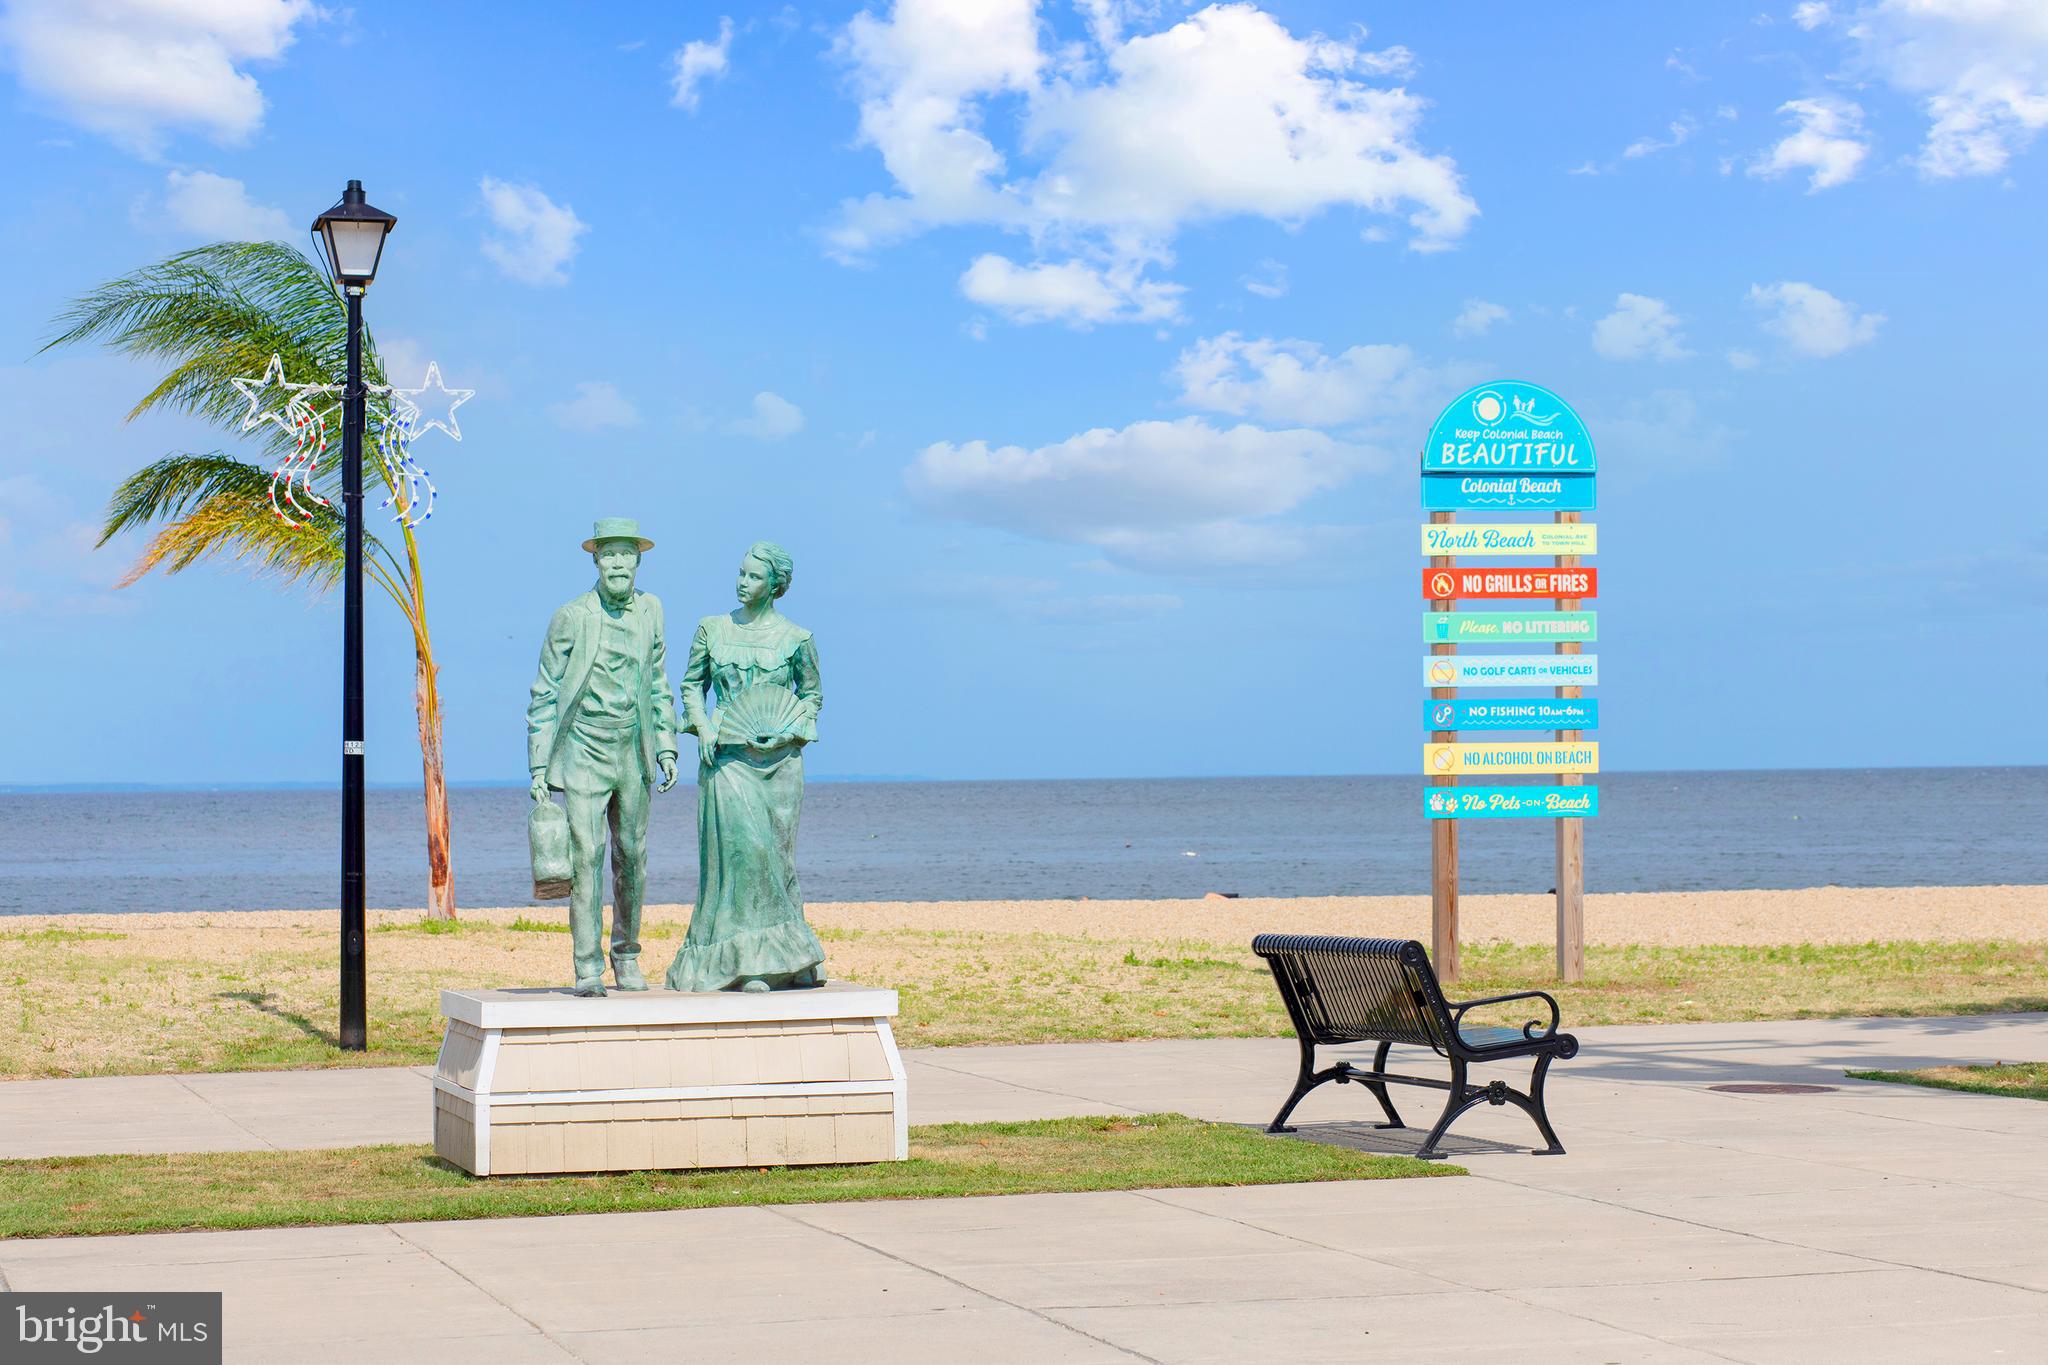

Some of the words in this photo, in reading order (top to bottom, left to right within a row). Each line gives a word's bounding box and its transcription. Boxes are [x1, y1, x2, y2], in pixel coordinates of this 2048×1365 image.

[1455, 428, 1480, 443] Keep
[1482, 429, 1528, 440] Colonial
[1531, 429, 1563, 440] Beach
[1441, 442, 1579, 465] BEAUTIFUL
[1461, 477, 1517, 493] Colonial
[1519, 478, 1562, 493] Beach
[1427, 530, 1479, 548] North
[1482, 530, 1536, 548] Beach
[1463, 575, 1482, 593] NO
[1485, 575, 1533, 592] GRILLS
[1535, 578, 1548, 589] OR
[1550, 574, 1589, 592] FIRES
[1502, 621, 1523, 634] NO
[1526, 620, 1590, 634] LITTERING
[1463, 667, 1478, 676] NO
[1480, 667, 1505, 676] GOLF
[1508, 666, 1537, 675] CARTS
[1550, 666, 1593, 675] VEHICLES
[1469, 707, 1488, 717] NO
[1490, 706, 1536, 716] FISHING
[1464, 752, 1480, 766] NO
[1483, 752, 1535, 766] ALCOHOL
[1536, 752, 1553, 765] ON
[1555, 751, 1592, 764] BEACH
[1462, 794, 1487, 810] No
[1489, 794, 1521, 810] Pets
[1545, 793, 1591, 809] Beach
